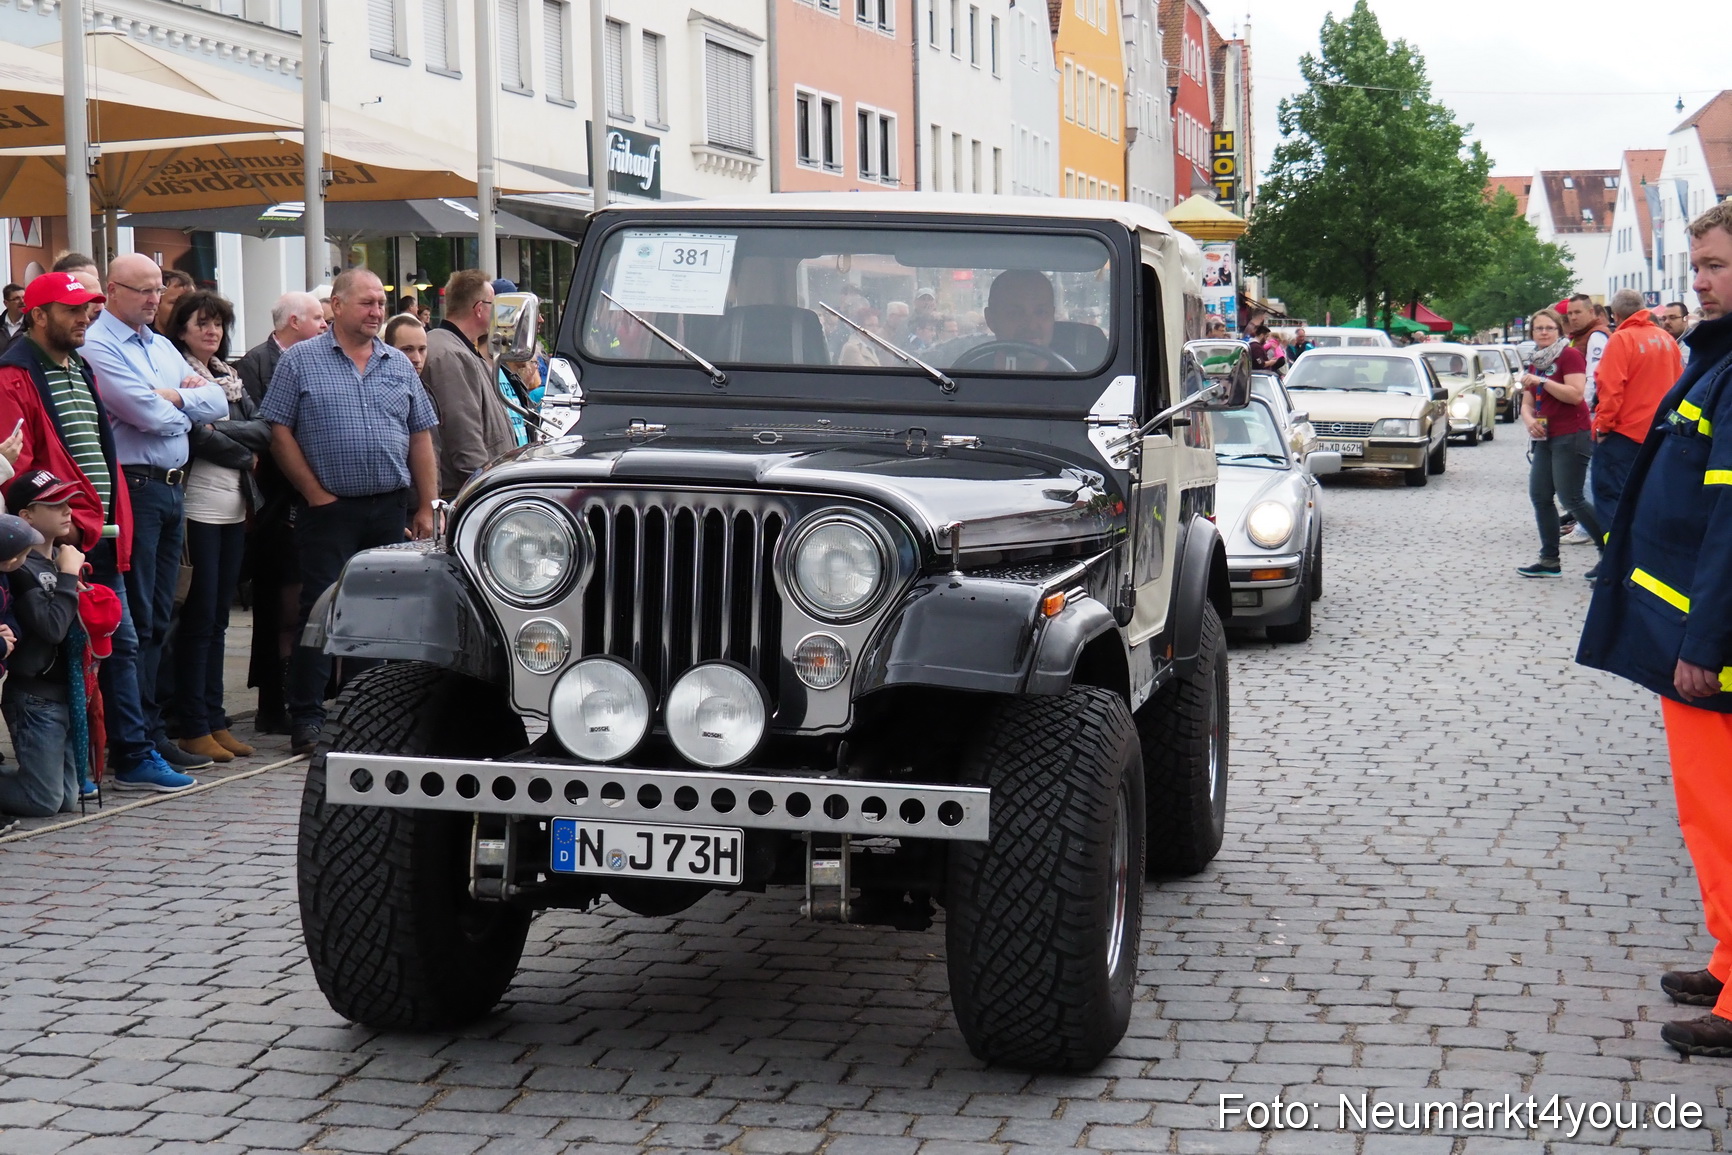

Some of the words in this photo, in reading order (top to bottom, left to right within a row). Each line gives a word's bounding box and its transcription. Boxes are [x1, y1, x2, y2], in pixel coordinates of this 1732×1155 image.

[672, 248, 710, 267] 381
[589, 725, 610, 733] BOSCH
[702, 731, 723, 739] BOSCH
[559, 850, 569, 862] D
[579, 828, 604, 867] N
[629, 831, 653, 870] J
[663, 833, 738, 876] 73H
